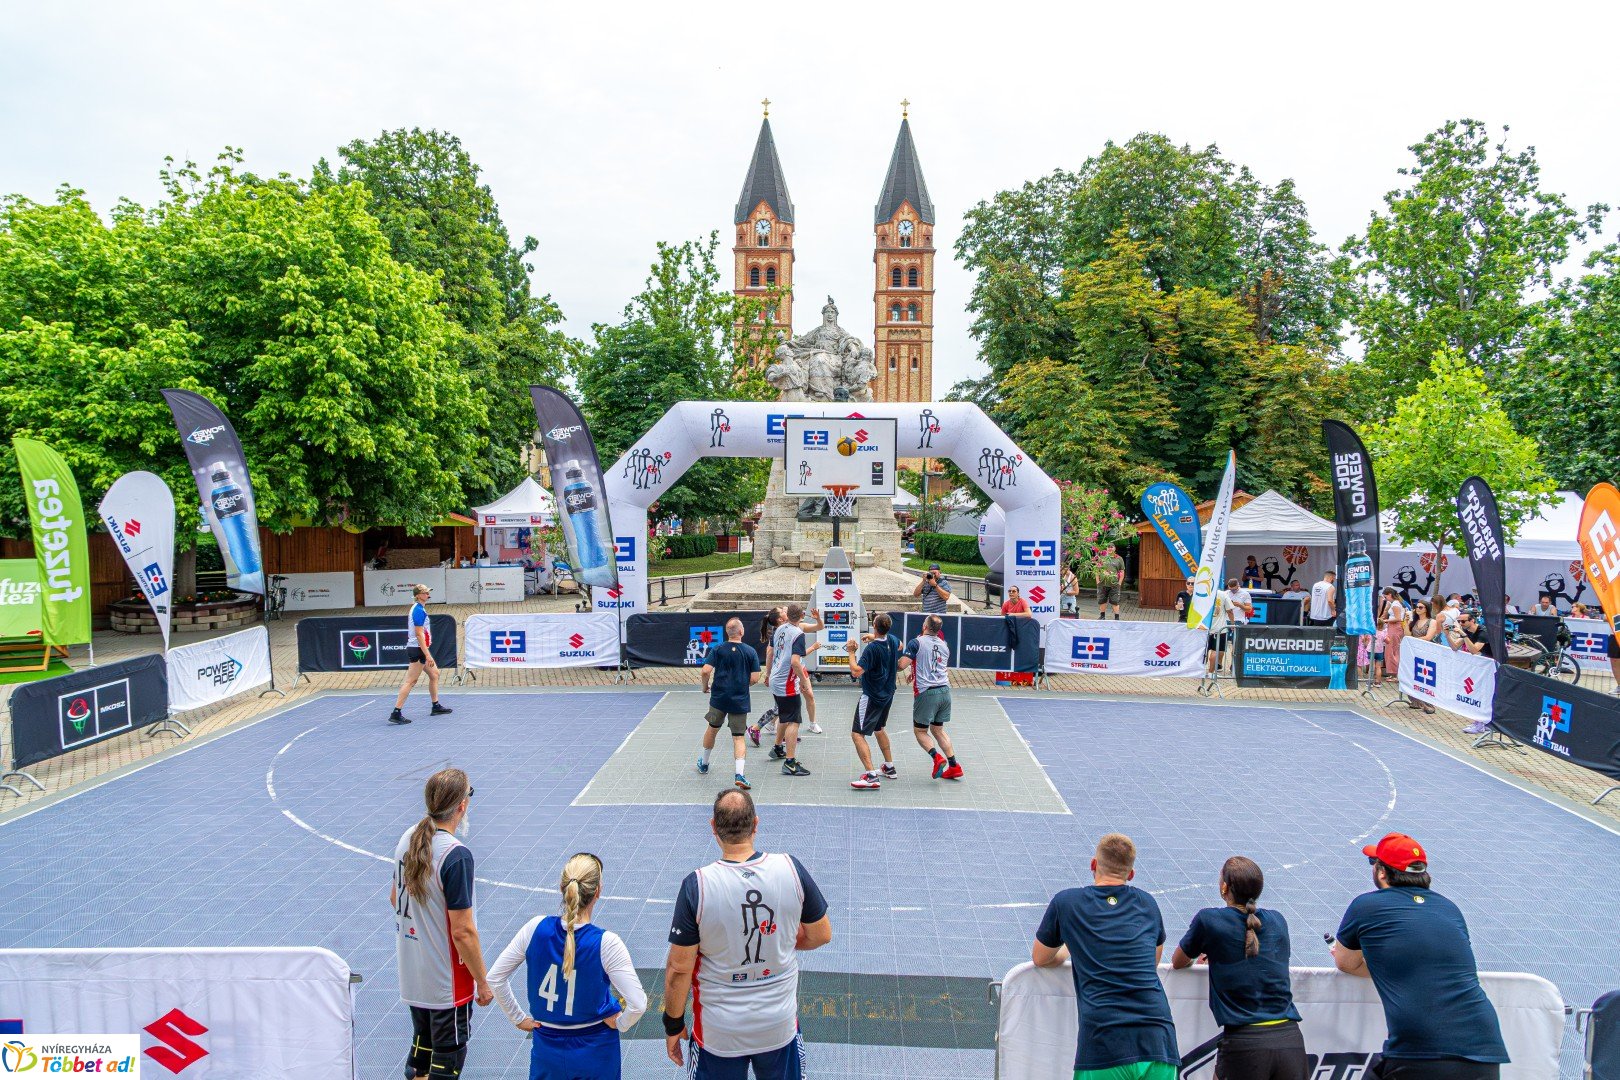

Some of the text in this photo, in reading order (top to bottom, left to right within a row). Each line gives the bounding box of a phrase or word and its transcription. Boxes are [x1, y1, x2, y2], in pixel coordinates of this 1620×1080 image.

[806, 531, 851, 540] KOSSTH
[0, 577, 41, 594] fuz
[597, 600, 635, 608] SUZUKI
[1030, 605, 1055, 613] ZUKI
[965, 644, 1006, 653] MKOSZ
[1244, 638, 1324, 651] POWERADE
[1144, 659, 1181, 667] SUZUKI
[197, 659, 235, 681] POWER
[213, 671, 235, 687] ADE
[100, 700, 126, 713] MKOSZ
[1455, 693, 1482, 708] SUZUKI
[538, 963, 577, 1017] 41
